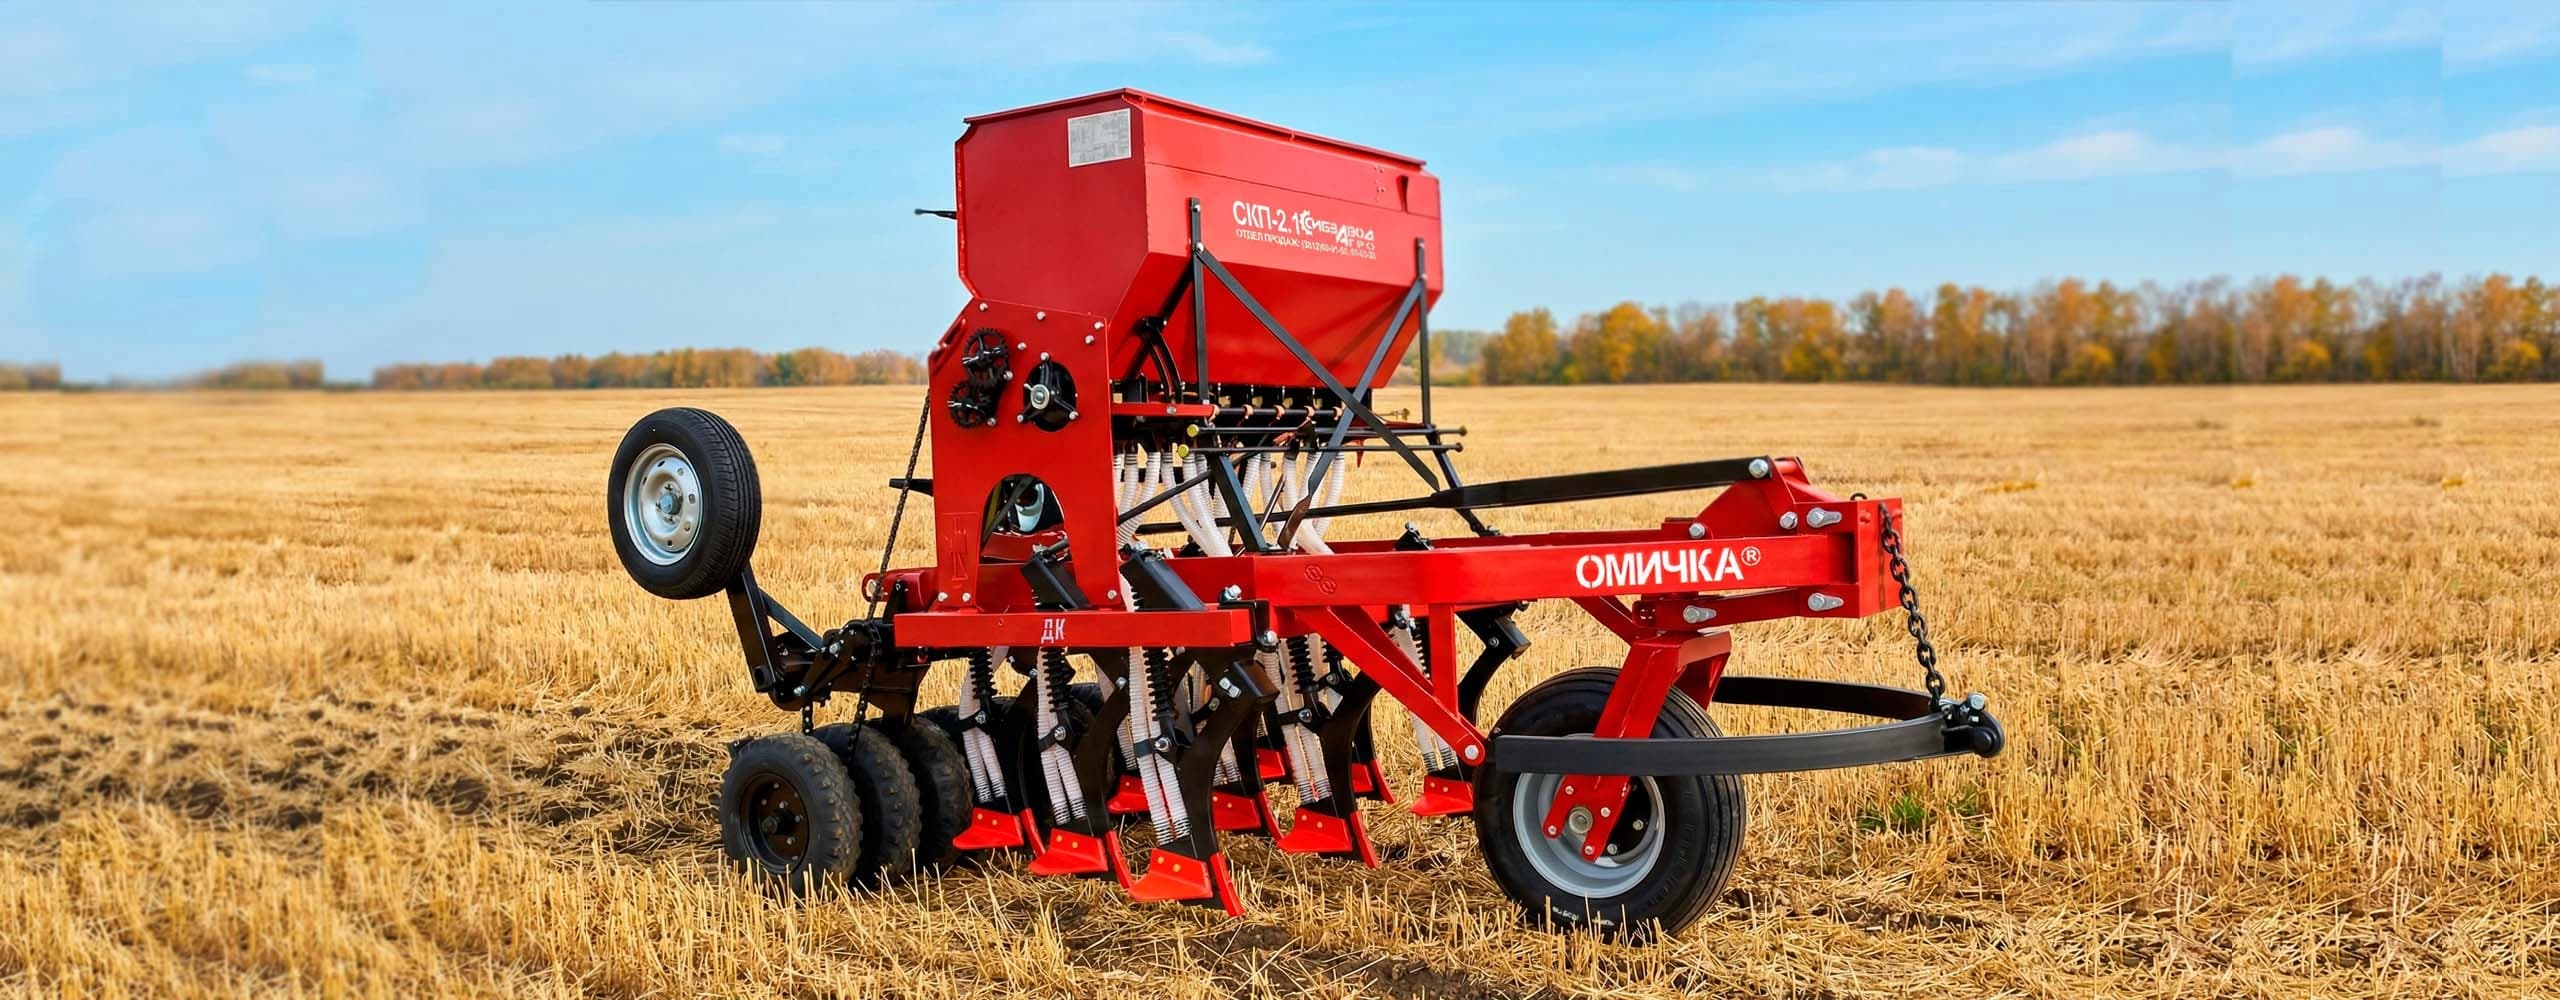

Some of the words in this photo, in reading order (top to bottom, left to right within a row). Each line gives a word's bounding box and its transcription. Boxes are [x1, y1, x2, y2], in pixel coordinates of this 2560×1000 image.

[1232, 200, 1300, 235] СКП-2.1
[1235, 228, 1264, 241] ОТДЕЛ
[1041, 618, 1065, 644] ДК
